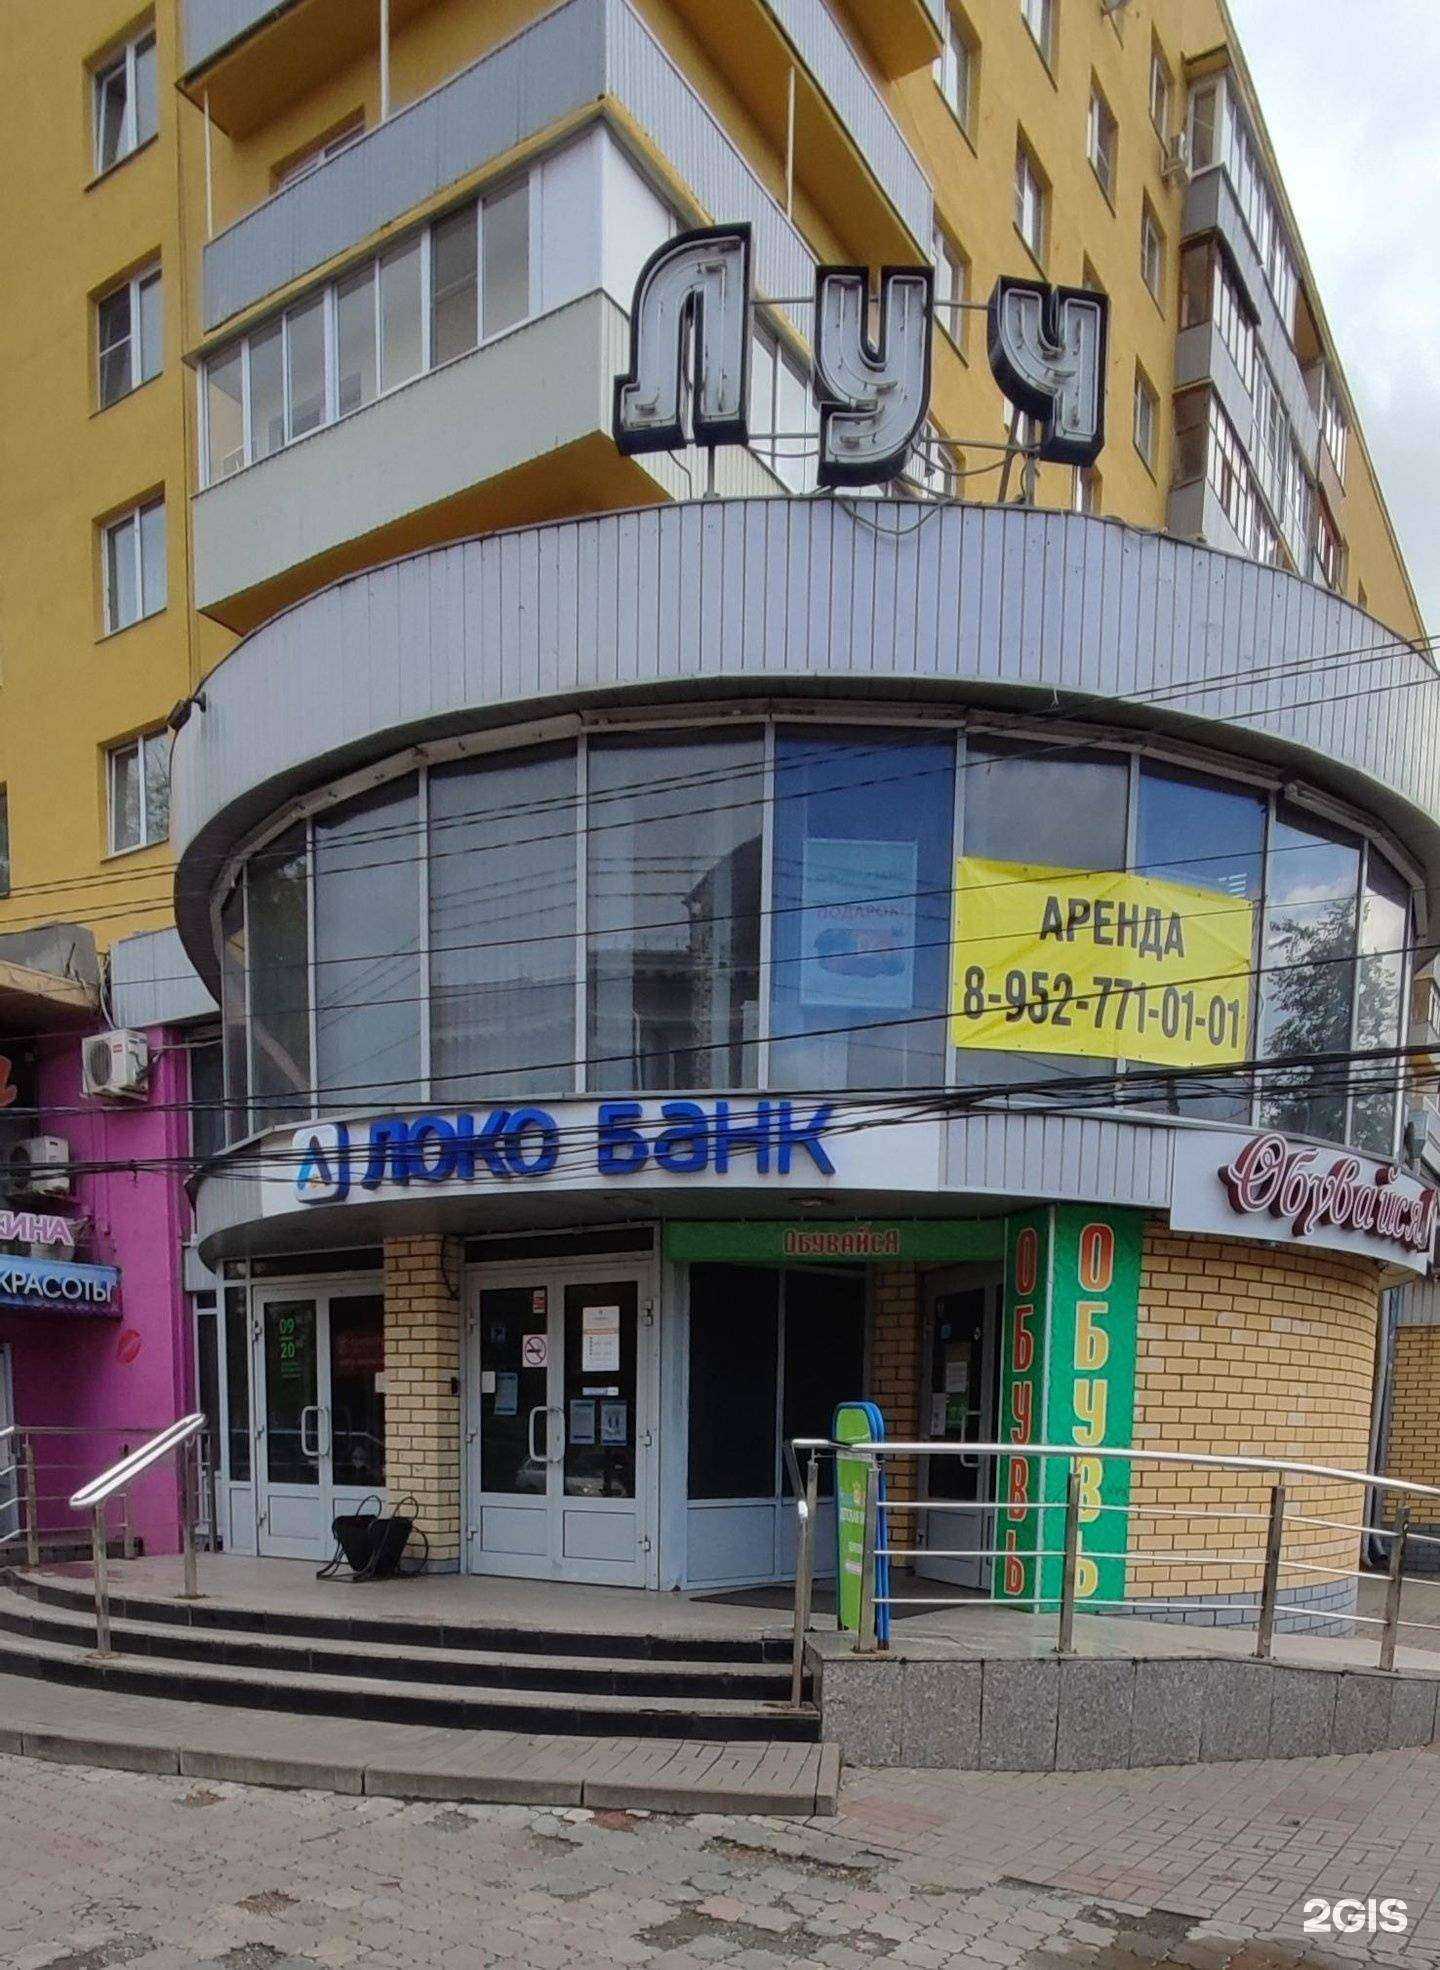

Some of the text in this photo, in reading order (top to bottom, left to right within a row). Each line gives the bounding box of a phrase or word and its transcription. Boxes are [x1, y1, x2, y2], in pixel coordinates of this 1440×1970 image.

[613, 222, 1110, 487] ЛУЧ
[963, 965, 1241, 1048] 8-952-771-01-01
[1039, 896, 1186, 961] АРЕНДА
[361, 1107, 559, 1190] ЛОКО
[1004, 1227, 1038, 1597] ОБУВЬ
[1070, 1222, 1115, 1598] ОБУВЬ
